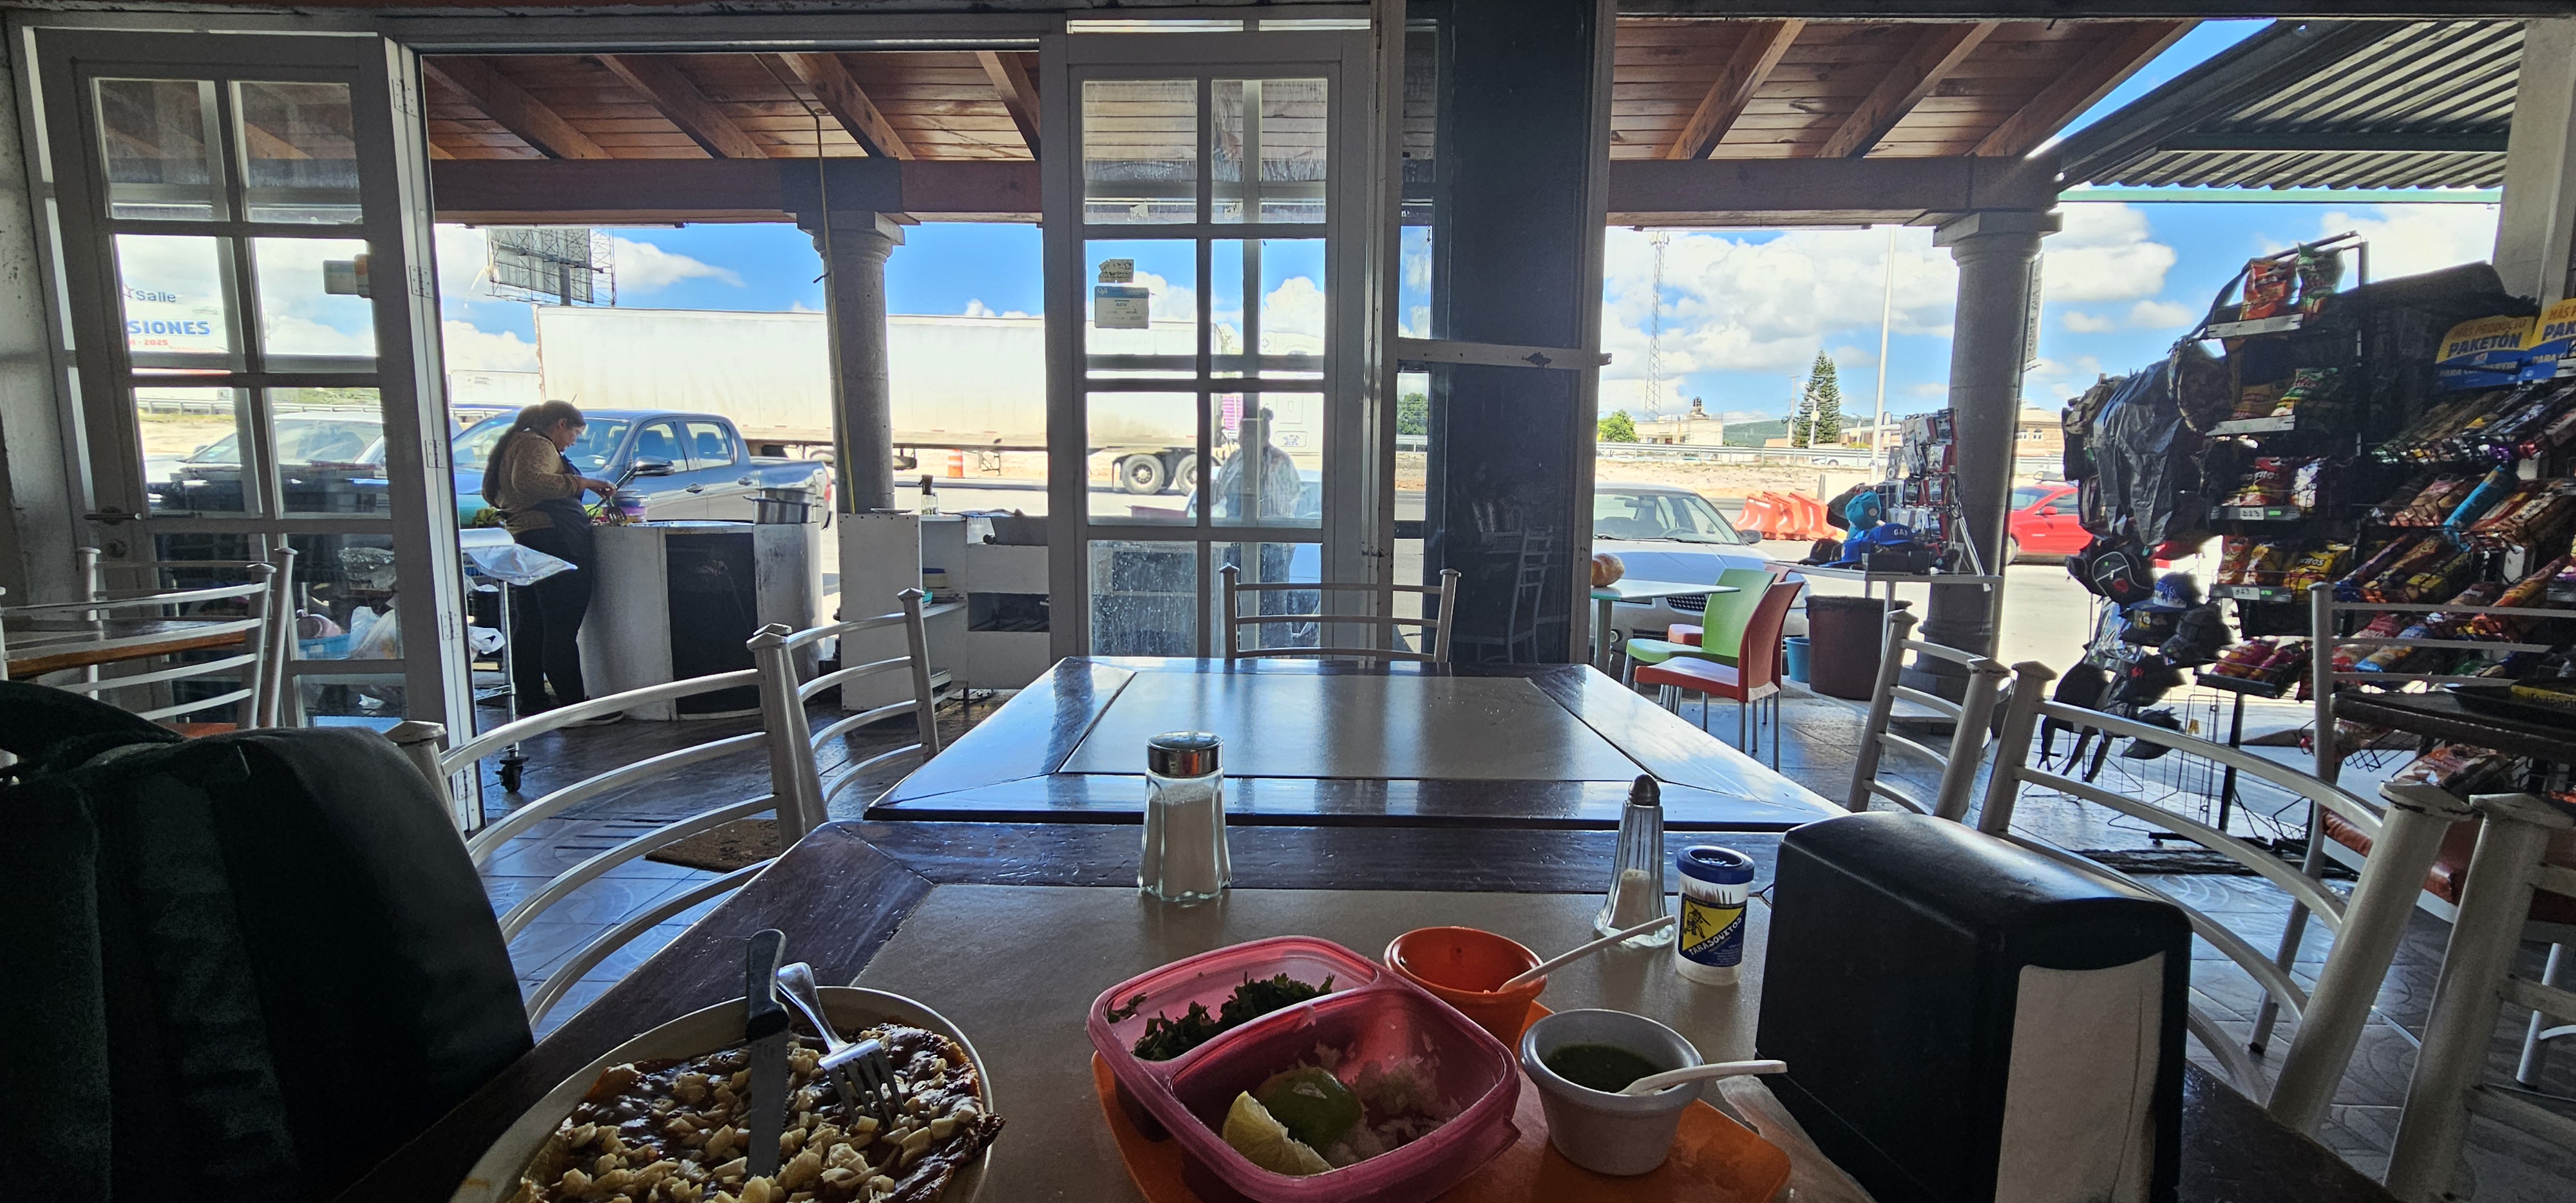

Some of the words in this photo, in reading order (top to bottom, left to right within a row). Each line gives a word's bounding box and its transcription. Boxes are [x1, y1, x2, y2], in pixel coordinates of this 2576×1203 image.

[136, 290, 176, 303] Salle
[129, 320, 211, 335] SIONES
[2447, 330, 2523, 357] PAKETÓN
